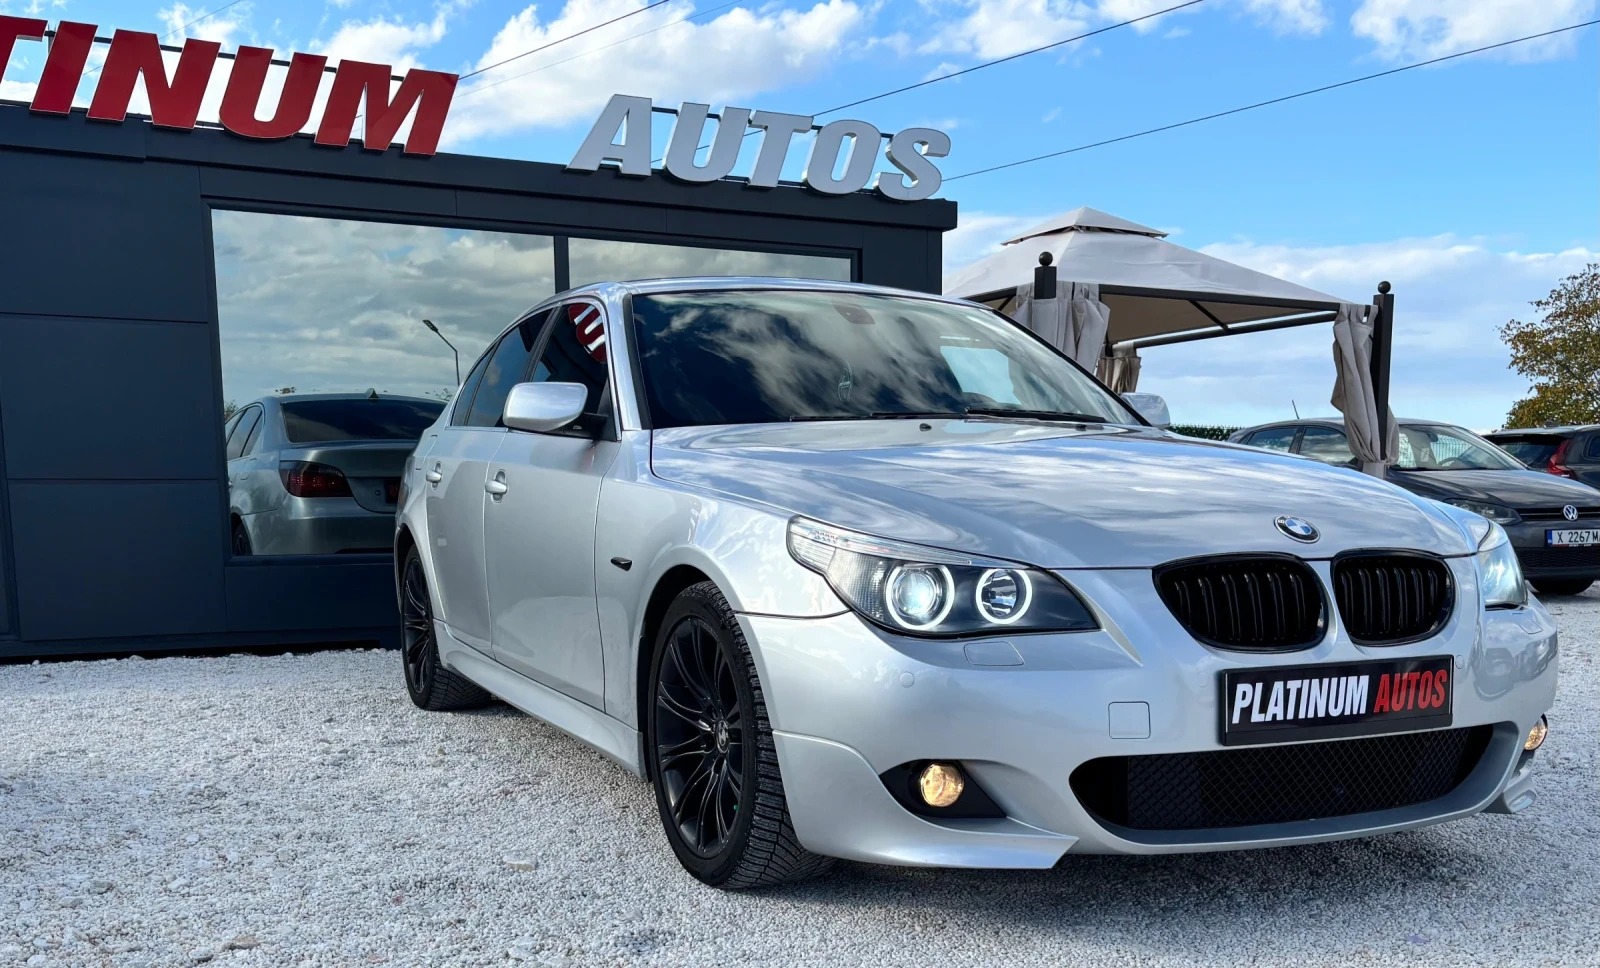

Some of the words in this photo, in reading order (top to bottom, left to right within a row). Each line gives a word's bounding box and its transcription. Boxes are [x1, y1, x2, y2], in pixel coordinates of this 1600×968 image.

[566, 93, 952, 201] AUTOS
[1557, 532, 1564, 543] X
[1568, 531, 1590, 543] 2267
[1592, 531, 1600, 542] M
[1231, 675, 1370, 725] PLATINUM
[1373, 669, 1448, 713] AUTOS
